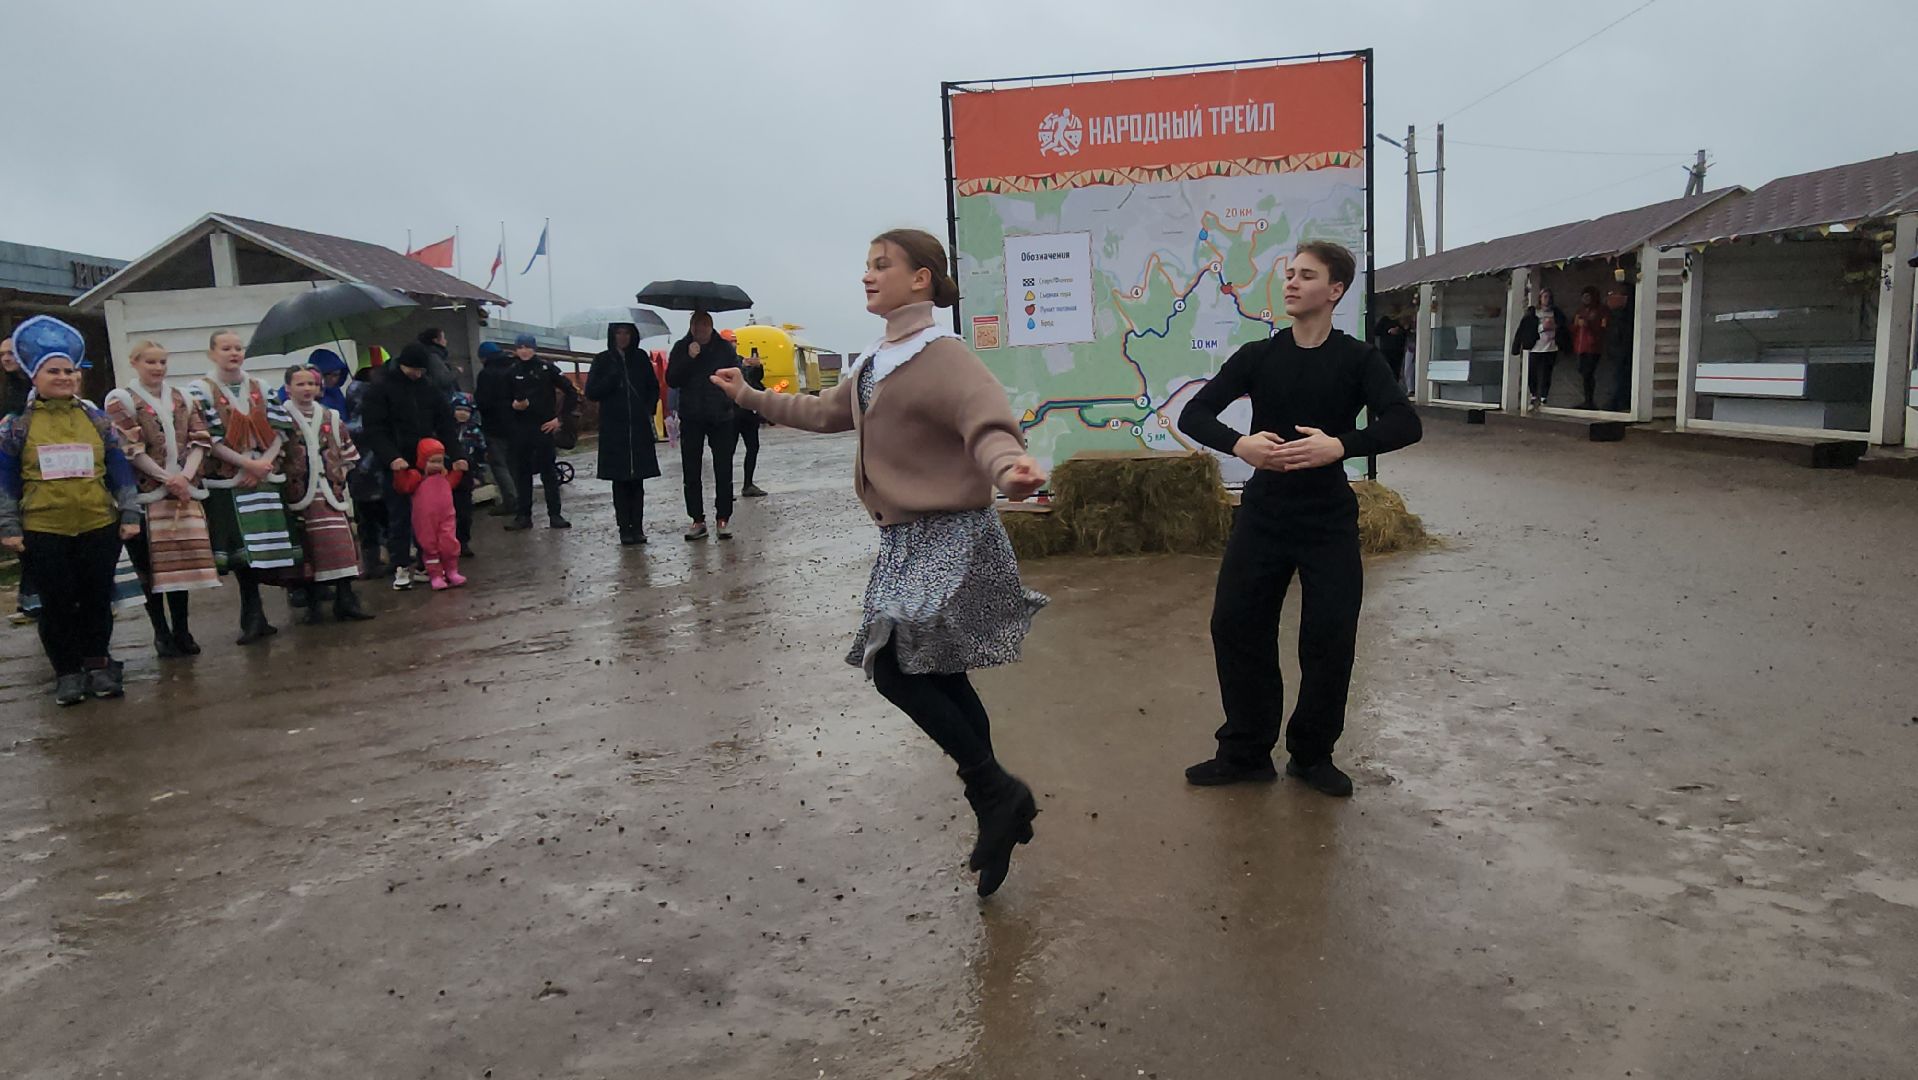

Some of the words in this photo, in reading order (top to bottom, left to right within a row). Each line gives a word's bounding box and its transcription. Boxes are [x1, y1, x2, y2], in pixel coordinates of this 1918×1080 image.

[1088, 104, 1203, 145] НАРОДНЫЙ
[1208, 98, 1275, 136] ТРЕЙЛ
[1225, 207, 1238, 218] 20
[1021, 252, 1070, 261] Обозначения
[1191, 339, 1204, 350] 10
[1147, 433, 1153, 442] 5
